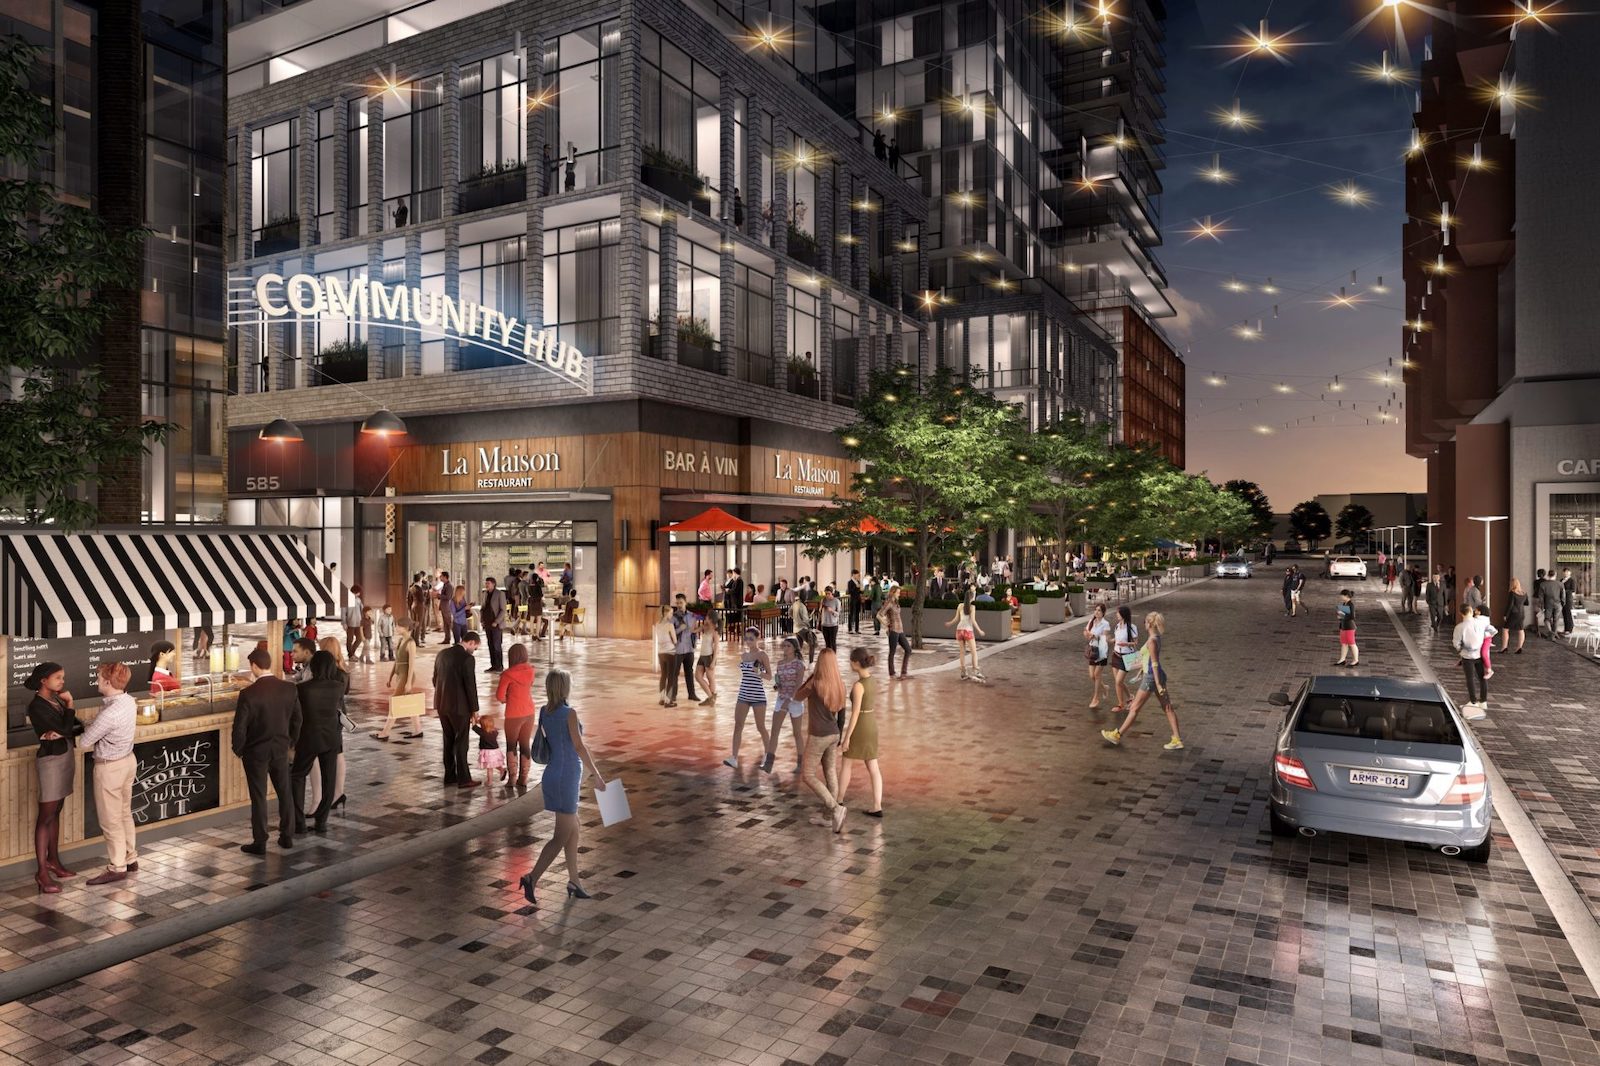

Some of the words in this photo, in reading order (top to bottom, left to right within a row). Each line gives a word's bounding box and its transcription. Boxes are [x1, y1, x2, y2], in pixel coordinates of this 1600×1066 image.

[256, 273, 517, 348] COMMUNITY
[522, 324, 585, 379] HUB
[441, 449, 468, 475] La
[478, 445, 560, 474] Maison
[664, 450, 696, 473] BAR
[700, 452, 710, 474] À
[714, 455, 738, 477] VIN
[774, 454, 792, 480] La
[798, 457, 841, 485] Maison
[246, 476, 280, 490] 585
[477, 477, 533, 489] RESTAURANT
[794, 484, 825, 496] RESTAURANT
[153, 740, 211, 770] just
[140, 767, 191, 791] ROLL
[151, 779, 206, 802] with
